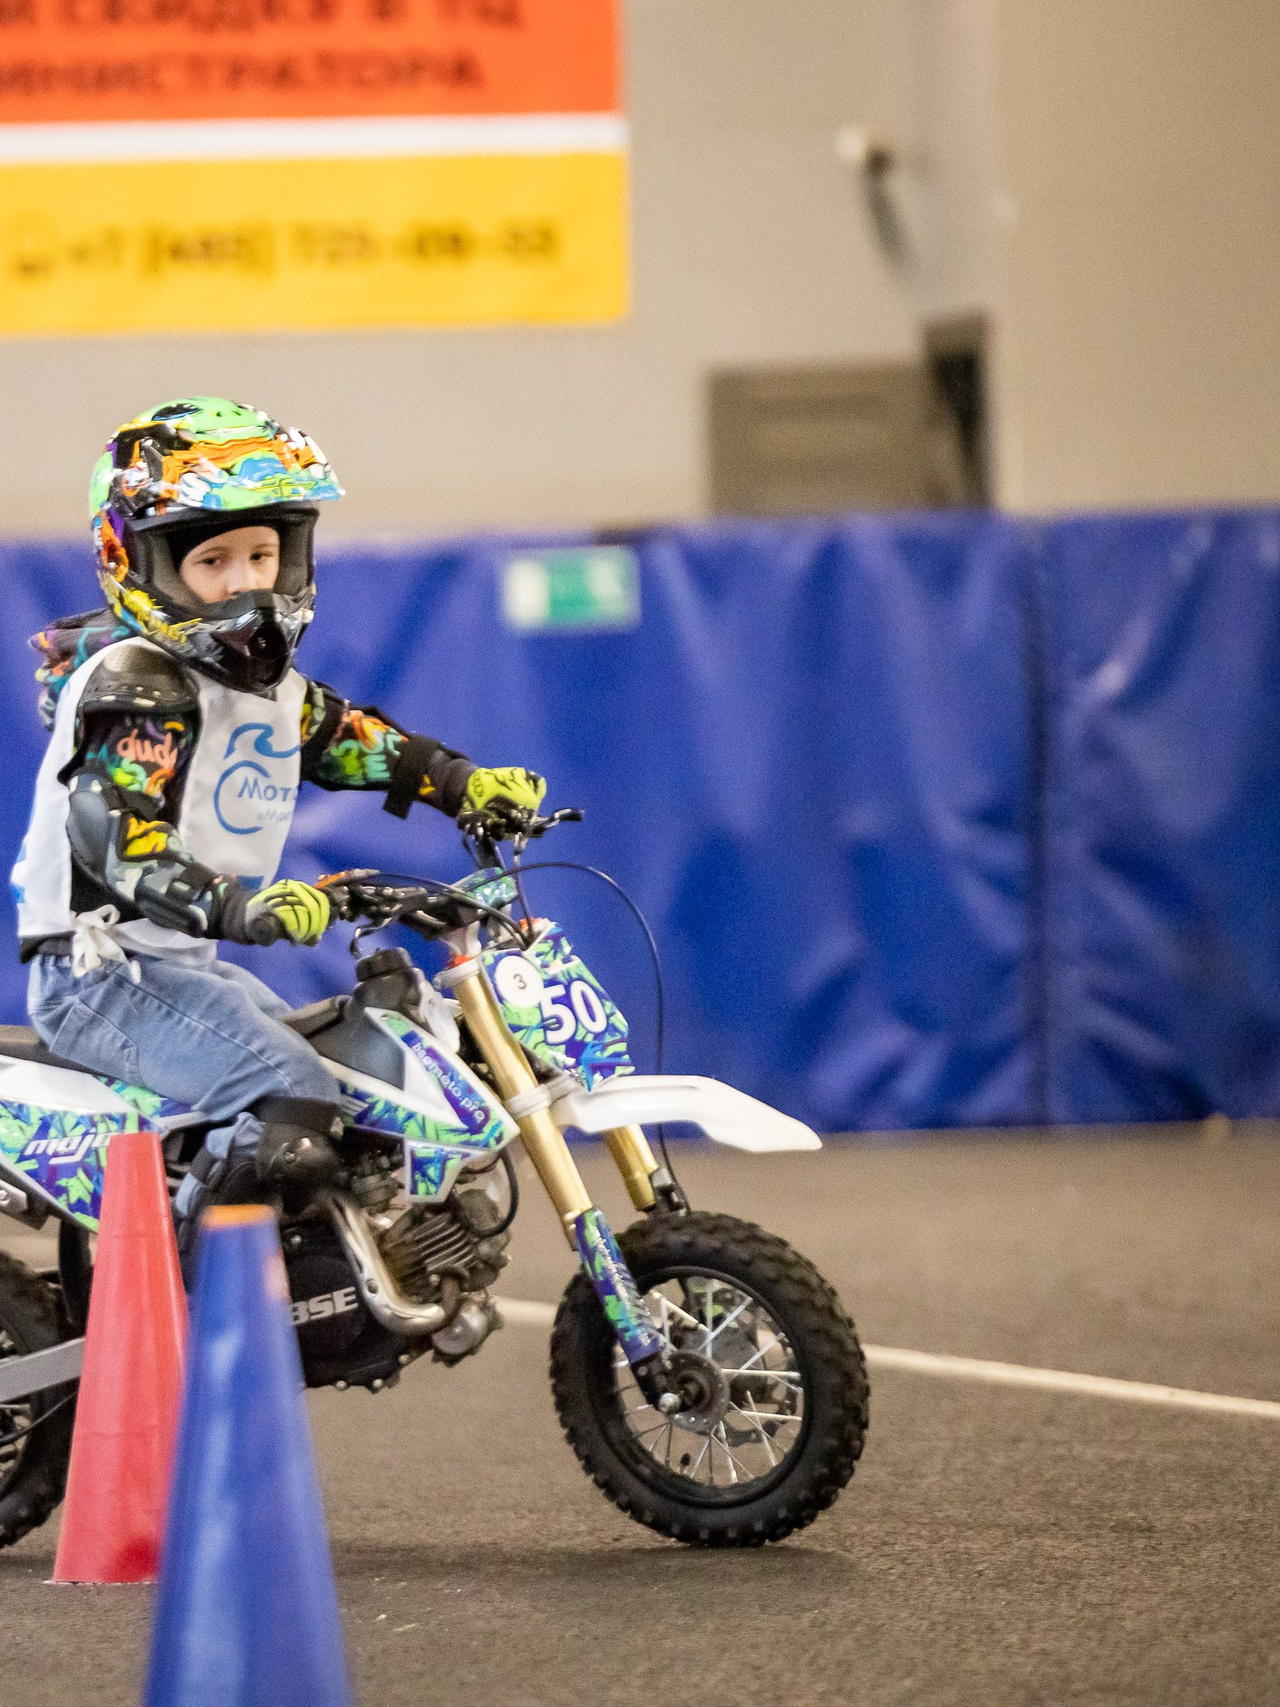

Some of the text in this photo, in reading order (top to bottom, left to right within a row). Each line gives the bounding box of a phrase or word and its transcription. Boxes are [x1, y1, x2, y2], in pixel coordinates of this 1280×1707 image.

[513, 972, 527, 990] 3
[540, 980, 608, 1045] 50
[291, 1286, 359, 1326] BSE
